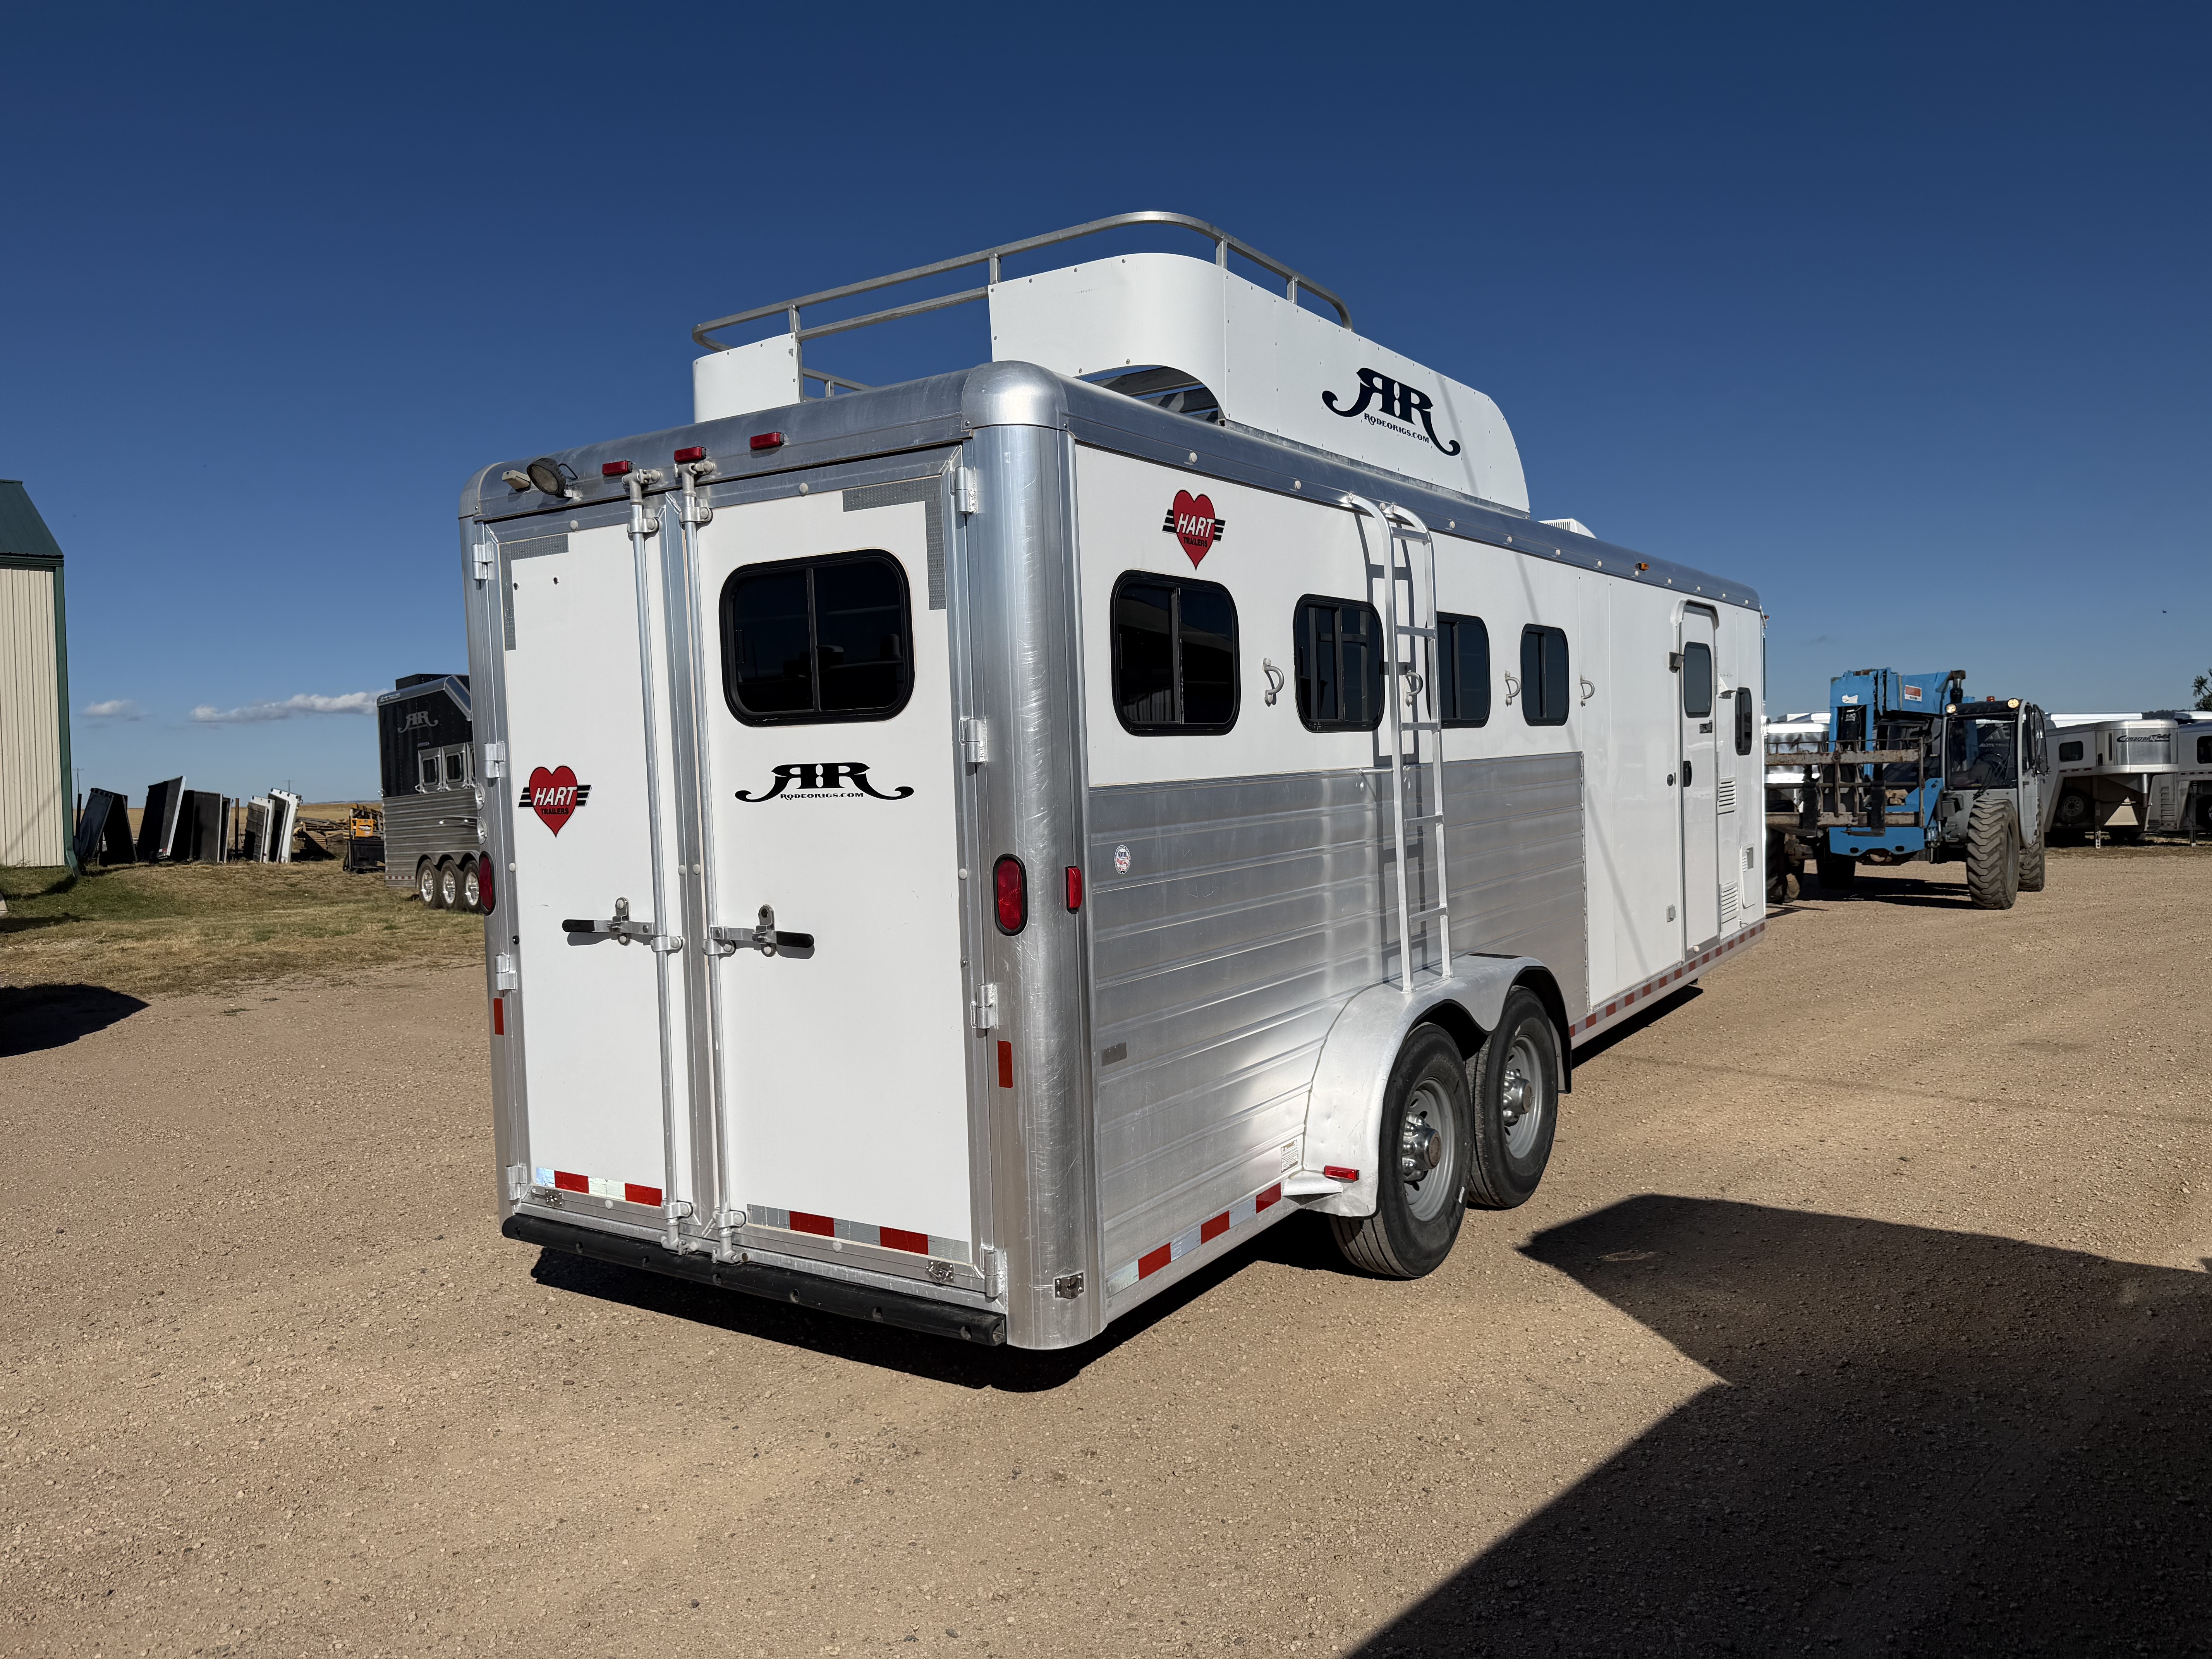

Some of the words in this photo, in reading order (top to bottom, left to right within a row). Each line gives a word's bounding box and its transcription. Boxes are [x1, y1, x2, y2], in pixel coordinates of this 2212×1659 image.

[1364, 412, 1429, 443] RODEORIGS.COM
[1176, 513, 1215, 537] HART
[1183, 537, 1207, 547] TRAILERS
[533, 786, 577, 806] HART
[780, 792, 864, 800] RODEORIGS.COM
